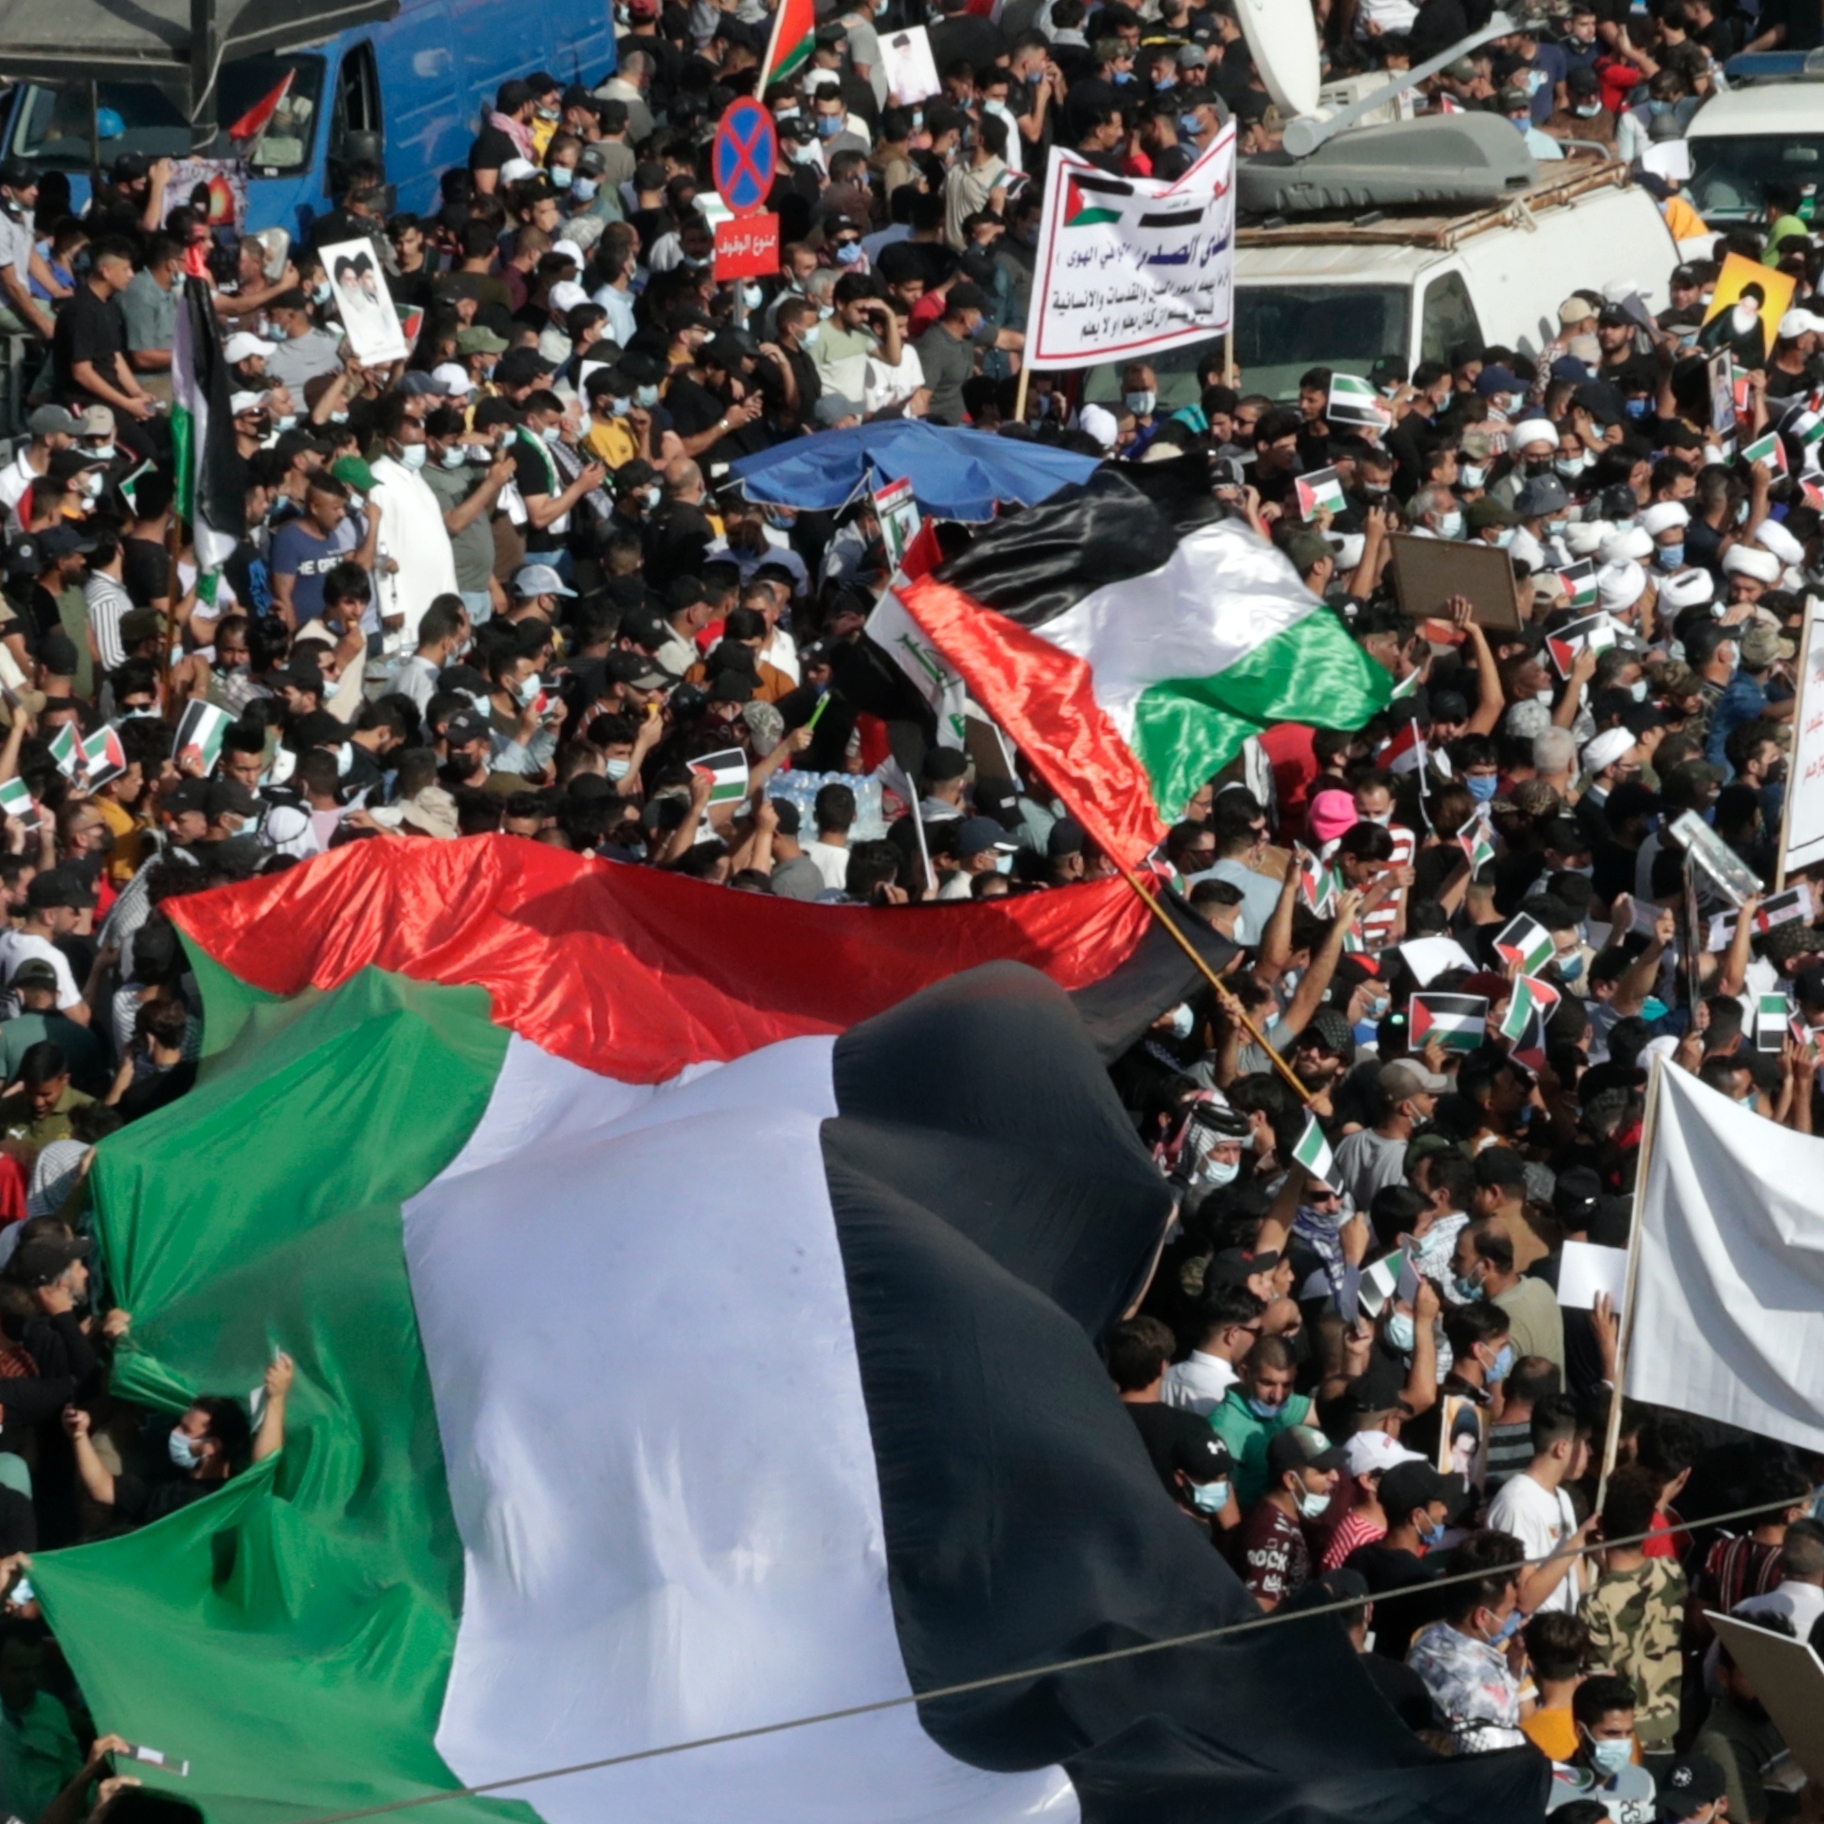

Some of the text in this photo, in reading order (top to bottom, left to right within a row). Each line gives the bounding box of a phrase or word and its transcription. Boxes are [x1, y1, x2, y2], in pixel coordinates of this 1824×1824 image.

[718, 233, 776, 258] ممنوع الوقوف
[1620, 1800, 1641, 1824] 25
